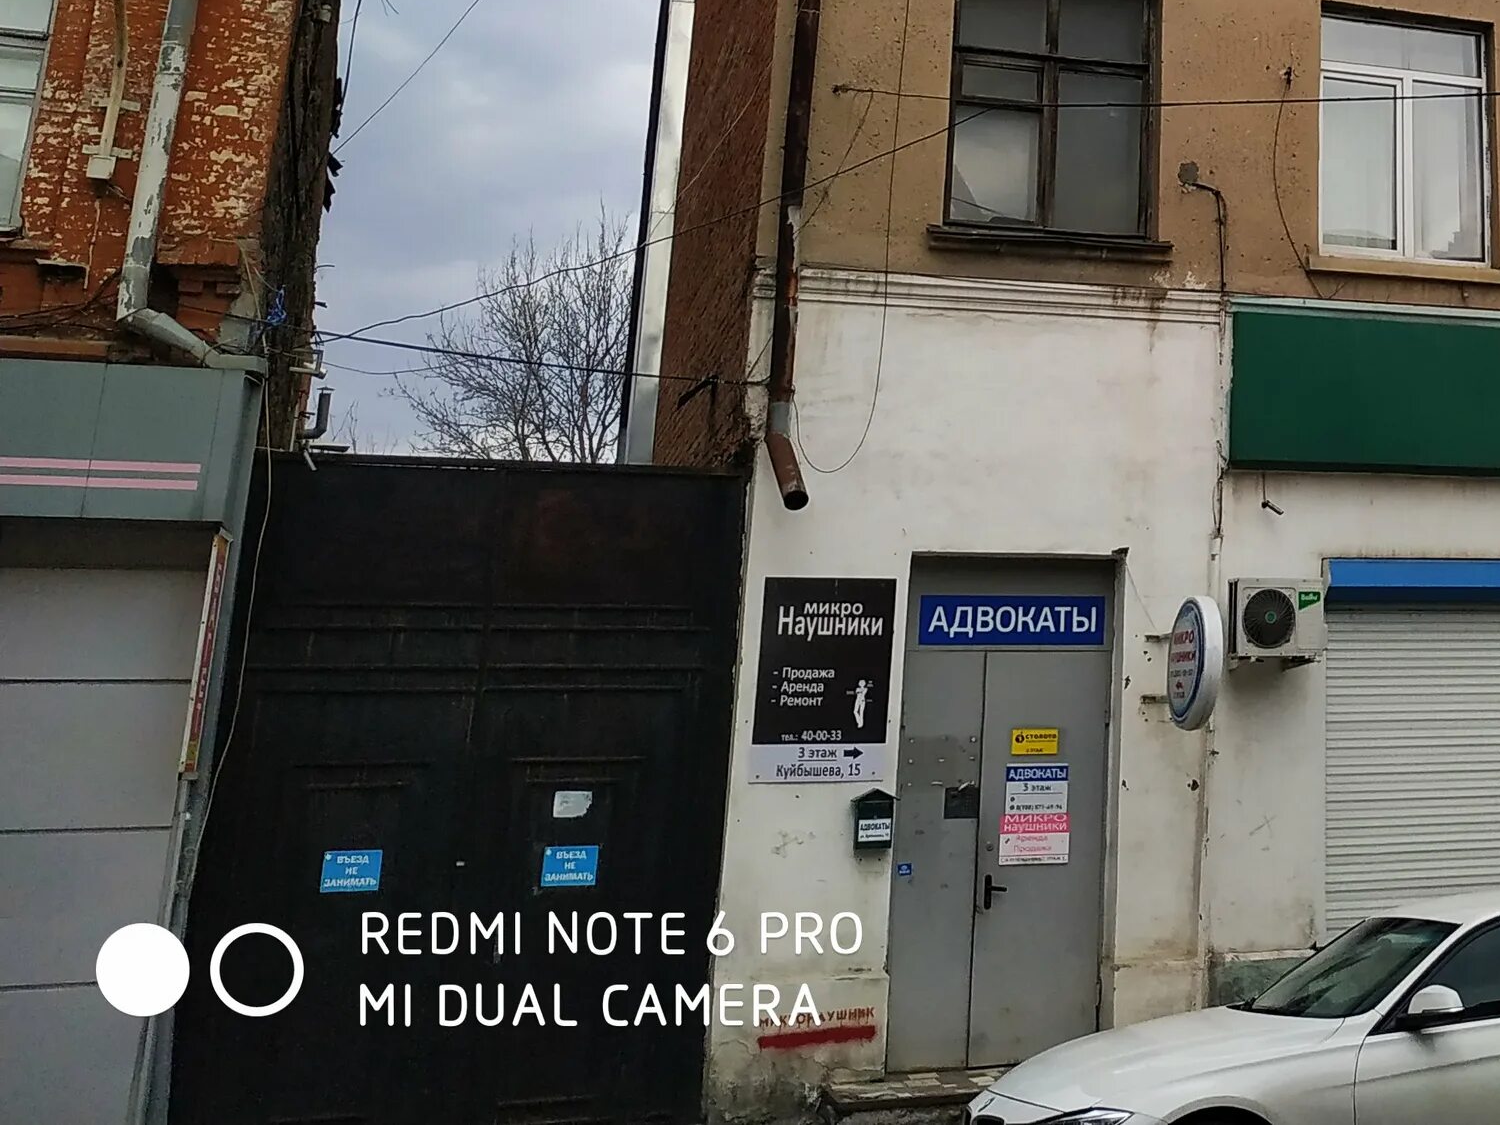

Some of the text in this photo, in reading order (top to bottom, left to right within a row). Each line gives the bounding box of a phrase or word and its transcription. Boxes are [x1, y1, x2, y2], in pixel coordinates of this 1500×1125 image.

[803, 602, 863, 618] микро
[777, 605, 884, 642] Наушники
[928, 605, 1097, 638] АДВОКАТЫ
[782, 667, 835, 679] Продажа
[780, 681, 824, 694] Аренда
[779, 695, 823, 707] Ремонт
[801, 730, 842, 741] 40-00-33
[798, 747, 837, 758] 3 этаж
[776, 764, 861, 779] Куйбышева, 15
[1008, 768, 1067, 780] АДВОКАТЫ
[1004, 814, 1067, 822] МИКРО
[1003, 823, 1067, 833] наушники
[336, 854, 369, 864] ВЪЕЗД
[555, 850, 587, 860] ВЪЕЗД
[345, 866, 358, 875] НЕ
[564, 861, 576, 870] НЕ
[544, 871, 594, 882] ЗАНИМАТЬ
[323, 877, 377, 888] ЗАНИМАТЬ
